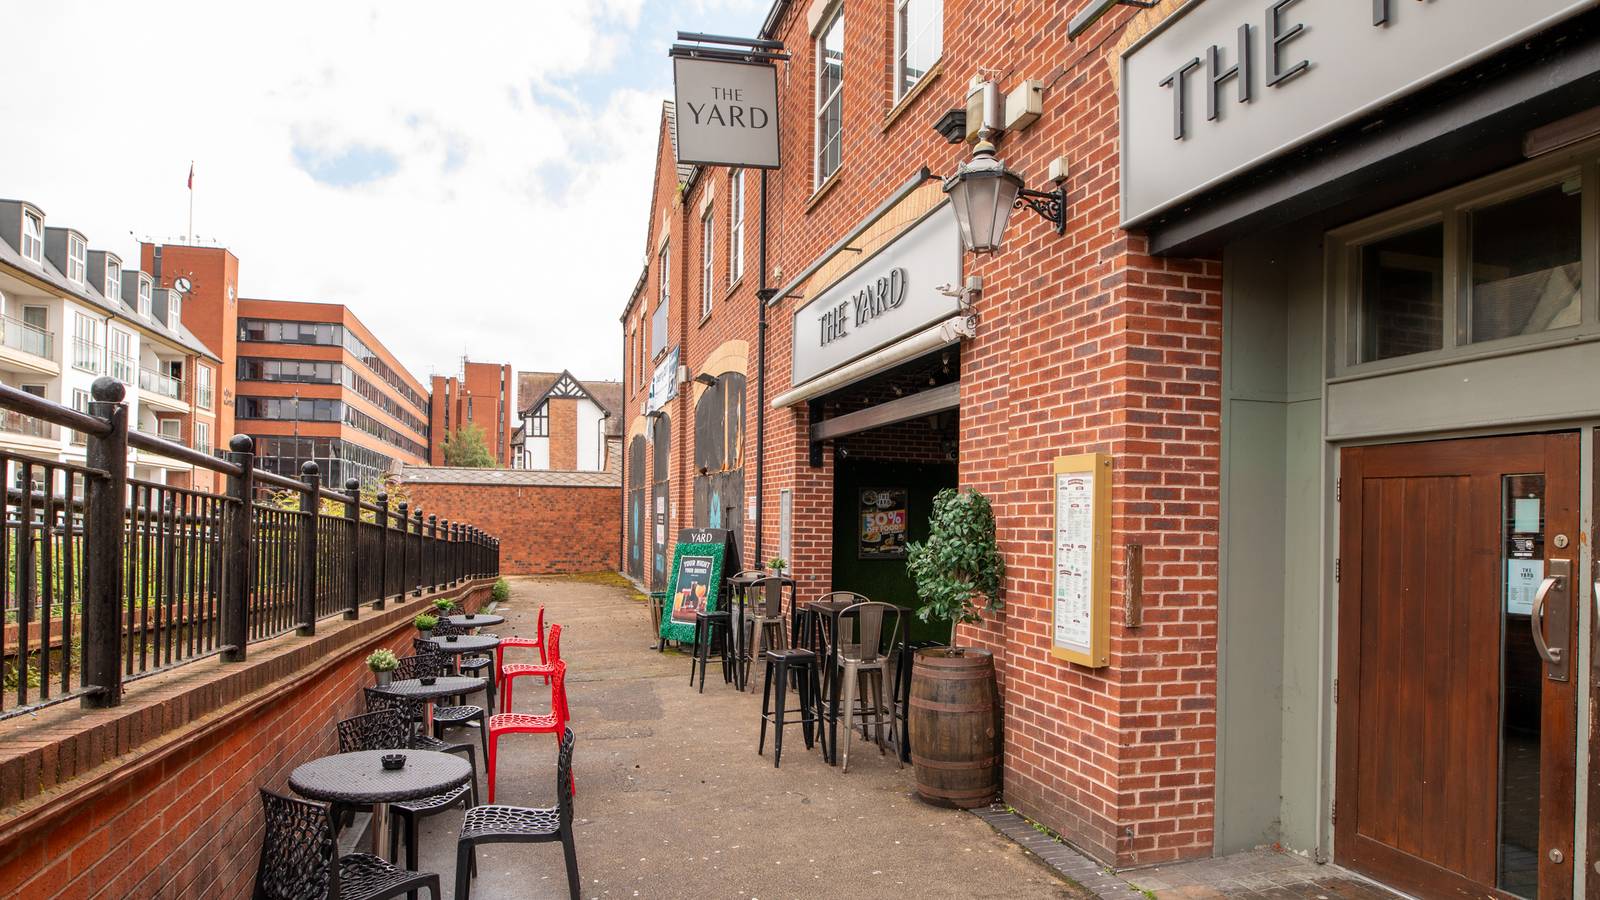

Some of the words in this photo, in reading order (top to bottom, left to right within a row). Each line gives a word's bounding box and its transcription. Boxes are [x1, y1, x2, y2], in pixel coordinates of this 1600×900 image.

[1158, 0, 1310, 141] THE
[711, 87, 744, 102] THE
[686, 102, 769, 129] YARD
[817, 300, 850, 347] THE
[852, 267, 907, 328] YARD
[866, 511, 902, 526] 50%
[691, 533, 713, 542] YARD
[683, 560, 696, 568] YOUR
[696, 560, 711, 569] NIGHT
